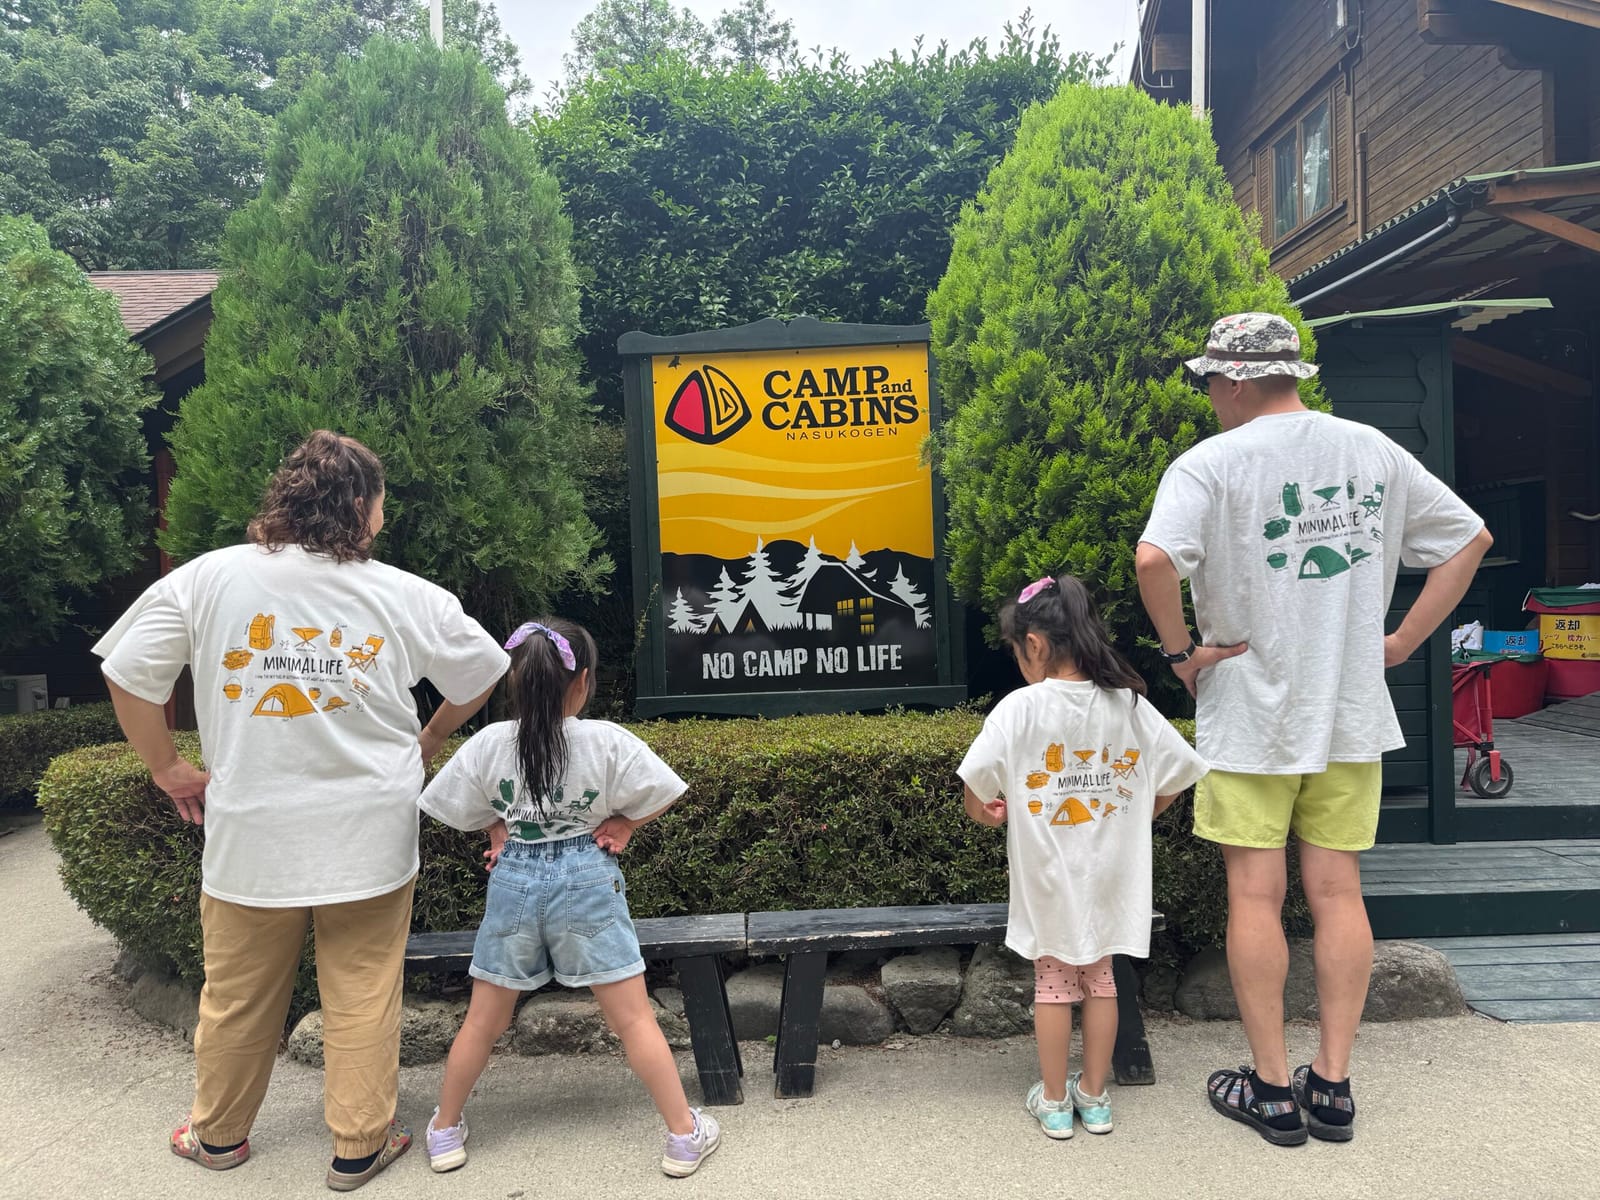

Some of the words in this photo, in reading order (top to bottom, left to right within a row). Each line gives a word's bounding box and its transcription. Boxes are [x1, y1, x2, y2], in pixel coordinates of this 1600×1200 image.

[763, 365, 889, 399] CAMP
[881, 379, 912, 393] and
[762, 394, 919, 430] CABINS
[786, 427, 898, 441] NASUKOGEN
[1297, 514, 1346, 537] MINIMAL
[1555, 619, 1580, 631] 返却
[1505, 635, 1527, 646] 返却
[263, 656, 316, 675] MINIMAL
[319, 659, 344, 675] LIFE
[702, 652, 735, 680] NO
[743, 649, 809, 678] CAMP
[816, 646, 849, 673] NO
[857, 644, 903, 672] LIFE
[1058, 773, 1094, 789] MINIMAL
[1096, 772, 1111, 787] LIFE
